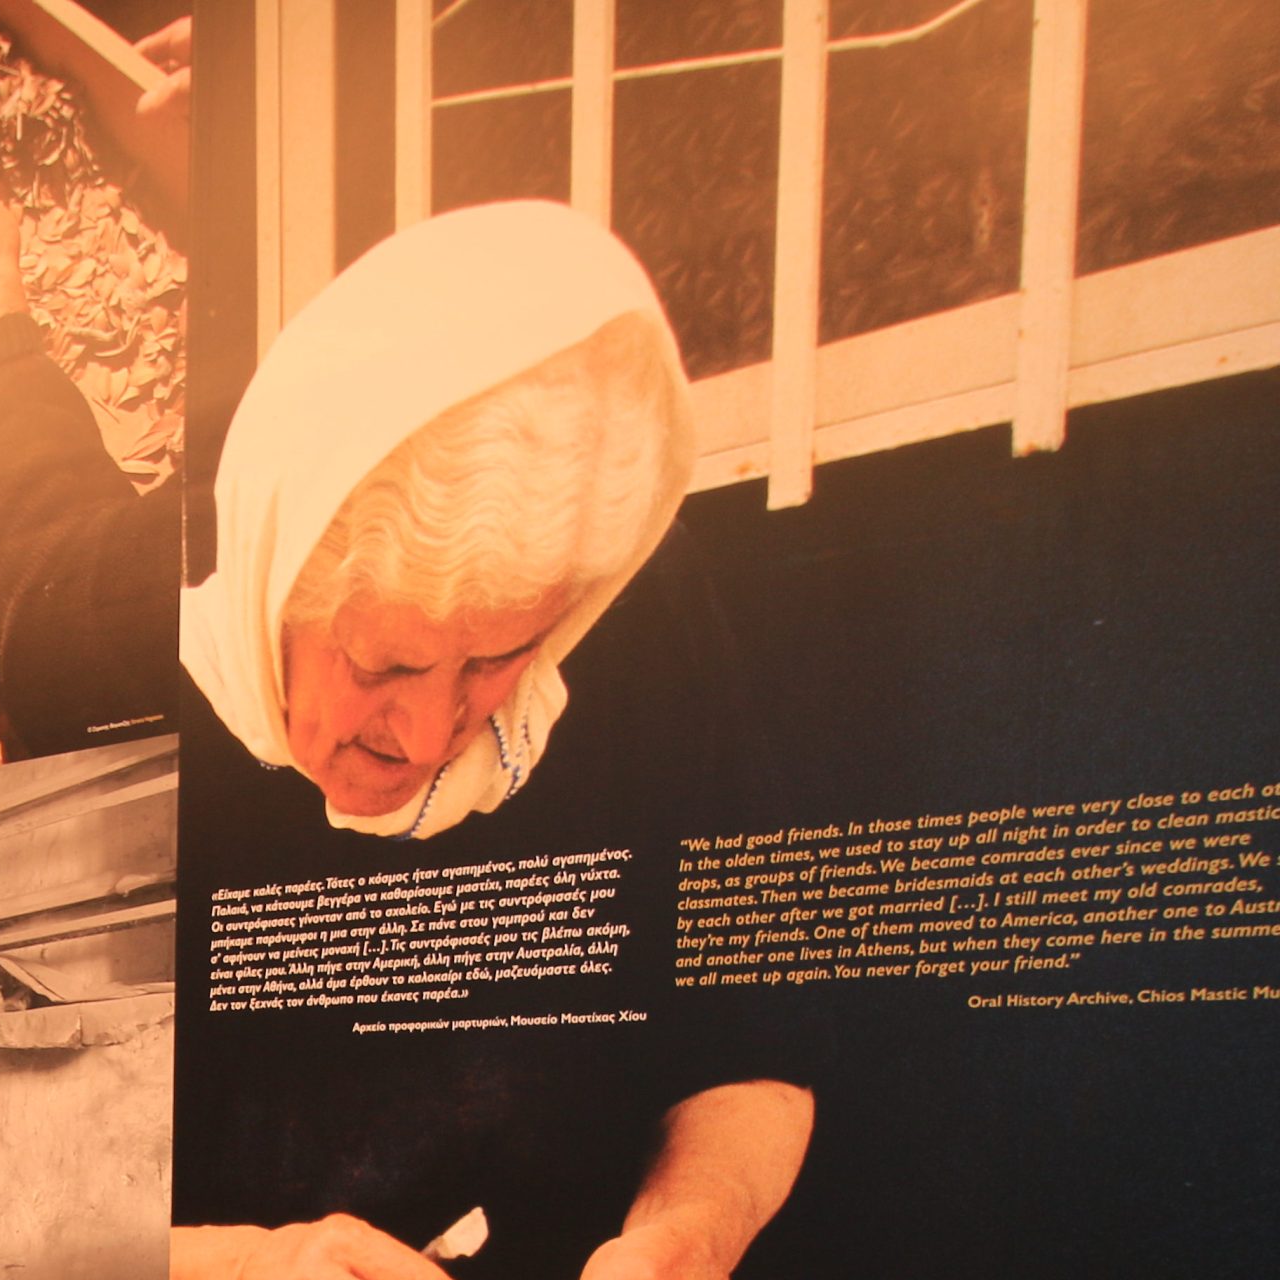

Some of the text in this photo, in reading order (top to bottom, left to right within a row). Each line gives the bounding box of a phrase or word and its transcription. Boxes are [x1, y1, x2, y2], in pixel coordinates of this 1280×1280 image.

[679, 858, 693, 872] In
[697, 856, 721, 871] the
[724, 852, 766, 868] olden
[770, 850, 815, 864] times,
[818, 847, 841, 859] we
[845, 839, 883, 857] used
[887, 840, 905, 853] to
[908, 837, 944, 852] stay
[948, 833, 971, 850] up
[975, 827, 998, 844] all
[1002, 825, 1048, 845] night
[1052, 824, 1070, 838] in
[1075, 819, 1126, 837] order
[1131, 818, 1152, 832] to
[1157, 813, 1210, 829] clean
[714, 833, 743, 849] had
[745, 829, 784, 850] good
[787, 823, 844, 846] friends.
[847, 821, 864, 836] In
[868, 818, 912, 834] those
[917, 814, 963, 829] times
[967, 804, 1027, 828] people
[1032, 804, 1076, 818] were
[1081, 799, 1122, 815] very
[1126, 793, 1175, 810] close
[1181, 791, 1202, 805] to
[1207, 783, 1255, 802] each
[211, 848, 633, 902] «Είχαμε καλές παρέες. Τότες ο κόσμος ήταν αγαπημένος, πολύ αγαπημένος.
[677, 895, 758, 911] classmates.
[760, 889, 798, 904] Then
[802, 889, 824, 900] we
[828, 883, 890, 899] became
[894, 871, 994, 893] bridesmaids
[999, 871, 1019, 885] at
[1023, 866, 1066, 884] each
[1141, 857, 1235, 875] weddings.
[1239, 851, 1271, 868] We
[678, 833, 1252, 893] drops, as groups of friends. We became comrades ever since we were
[211, 867, 621, 917] Παλαιά, να κάτσουμε βεγγέρα να καθαρίσουμε μαστίχι, παρέες όλη νύχτα.
[676, 916, 694, 933] by
[697, 913, 731, 929] each
[735, 910, 776, 926] other
[780, 907, 818, 925] after
[822, 907, 844, 919] we
[847, 904, 875, 921] got
[879, 896, 945, 915] married
[993, 892, 1001, 907] I
[1005, 890, 1038, 906] still
[1041, 889, 1089, 904] meet
[1094, 888, 1122, 904] my
[1127, 882, 1158, 899] old
[1163, 876, 1263, 897] comrades,
[675, 953, 703, 968] and
[706, 950, 764, 966] another
[767, 951, 795, 963] one
[799, 947, 833, 961] lives
[837, 945, 852, 958] in
[855, 942, 915, 957] Athens,
[919, 939, 948, 954] but
[952, 936, 998, 952] when
[1003, 934, 1041, 952] they
[1046, 934, 1095, 947] come
[1100, 929, 1143, 944] here
[1148, 928, 1167, 942] in
[1173, 925, 1205, 941] the
[728, 934, 751, 948] my
[754, 927, 809, 947] friends.
[813, 925, 846, 940] One
[851, 922, 870, 940] of
[872, 921, 914, 936] them
[919, 915, 975, 933] moved
[979, 917, 998, 929] to
[1000, 911, 1078, 927] America,
[1083, 906, 1158, 924] another
[1163, 906, 1199, 919] one
[1205, 903, 1226, 917] to
[675, 976, 695, 987] we
[698, 971, 718, 986] all
[720, 971, 759, 985] meet
[762, 970, 782, 986] up
[786, 966, 832, 985] again.
[834, 964, 861, 979] You
[866, 964, 911, 977] never
[915, 959, 966, 978] forget
[970, 959, 1010, 976] your
[967, 995, 1003, 1008] Oral
[1007, 994, 1064, 1009] History
[1066, 991, 1133, 1005] Archive,
[1137, 989, 1185, 1003] Chios
[1190, 988, 1247, 1001] Mastic
[352, 1010, 647, 1035] Αρχείο προφορικών μαρτυριών, Μουσείο Μαστίχας Χίου
